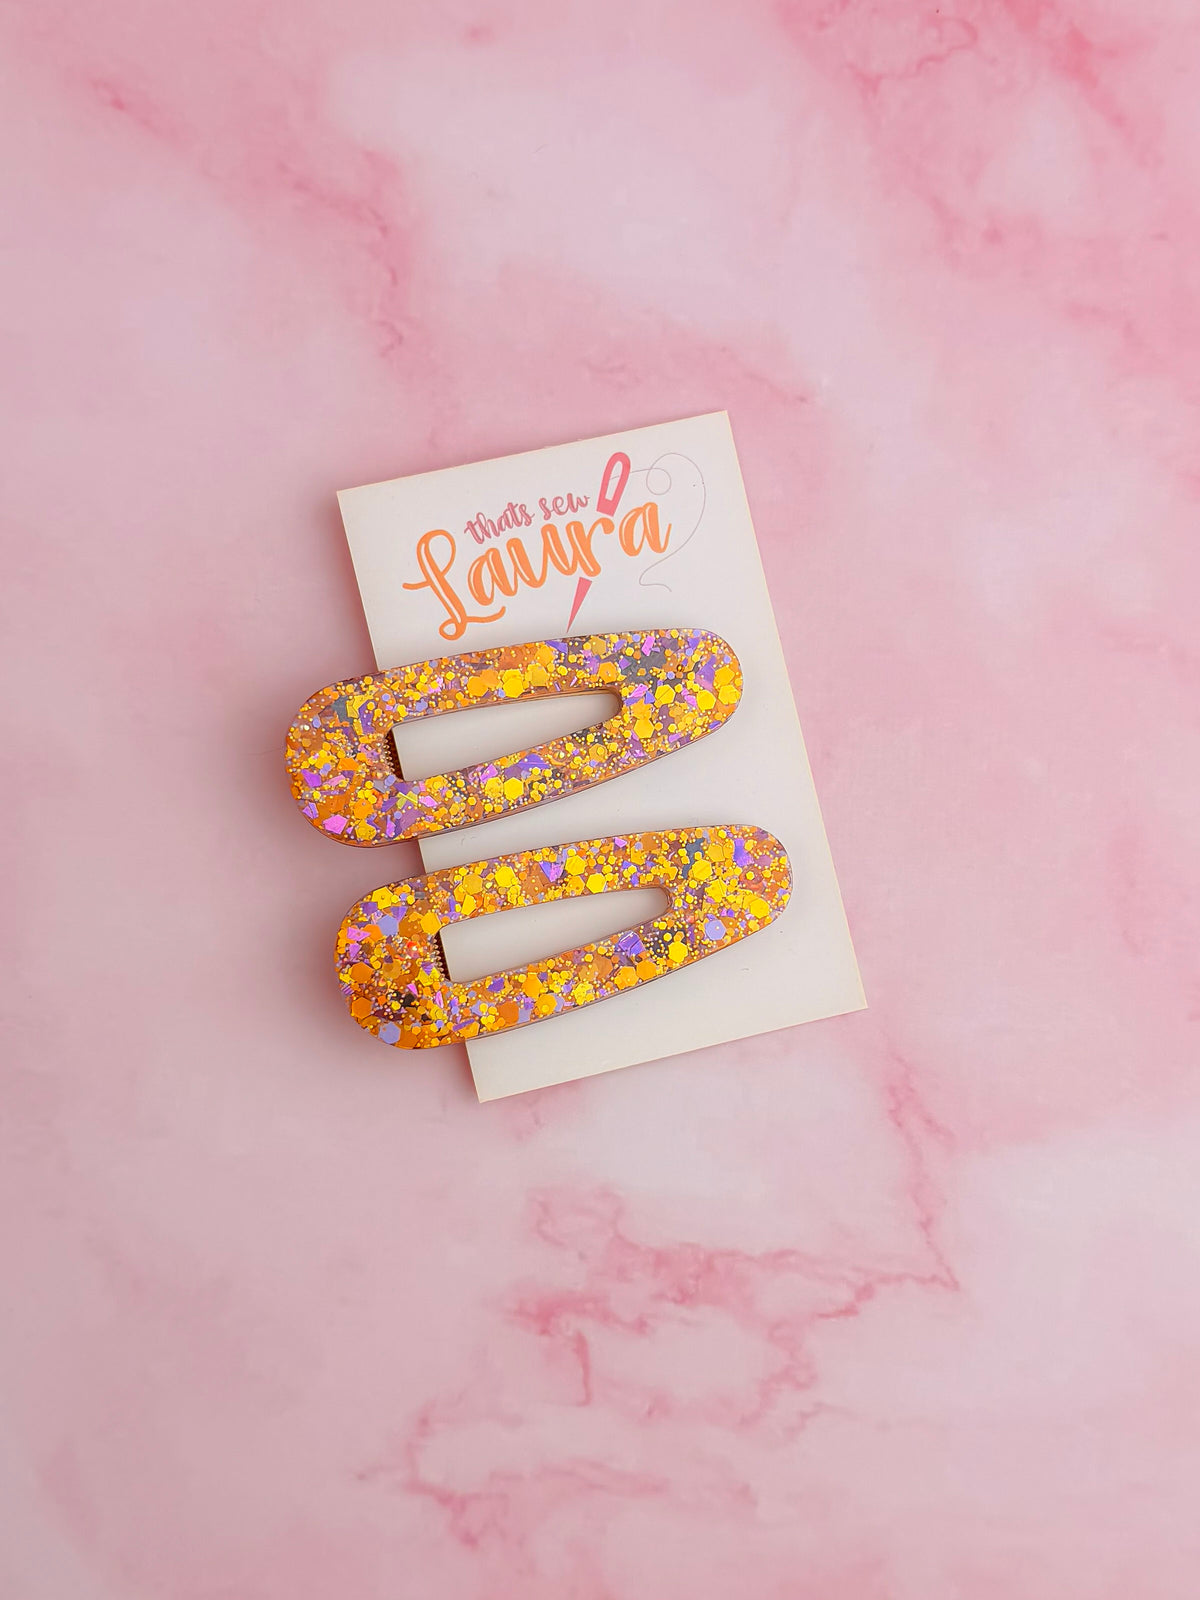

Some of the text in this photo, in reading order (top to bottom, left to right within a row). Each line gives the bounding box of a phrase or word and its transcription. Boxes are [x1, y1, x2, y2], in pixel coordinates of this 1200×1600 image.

[464, 493, 590, 544] thats sew
[402, 502, 672, 641] Laura
